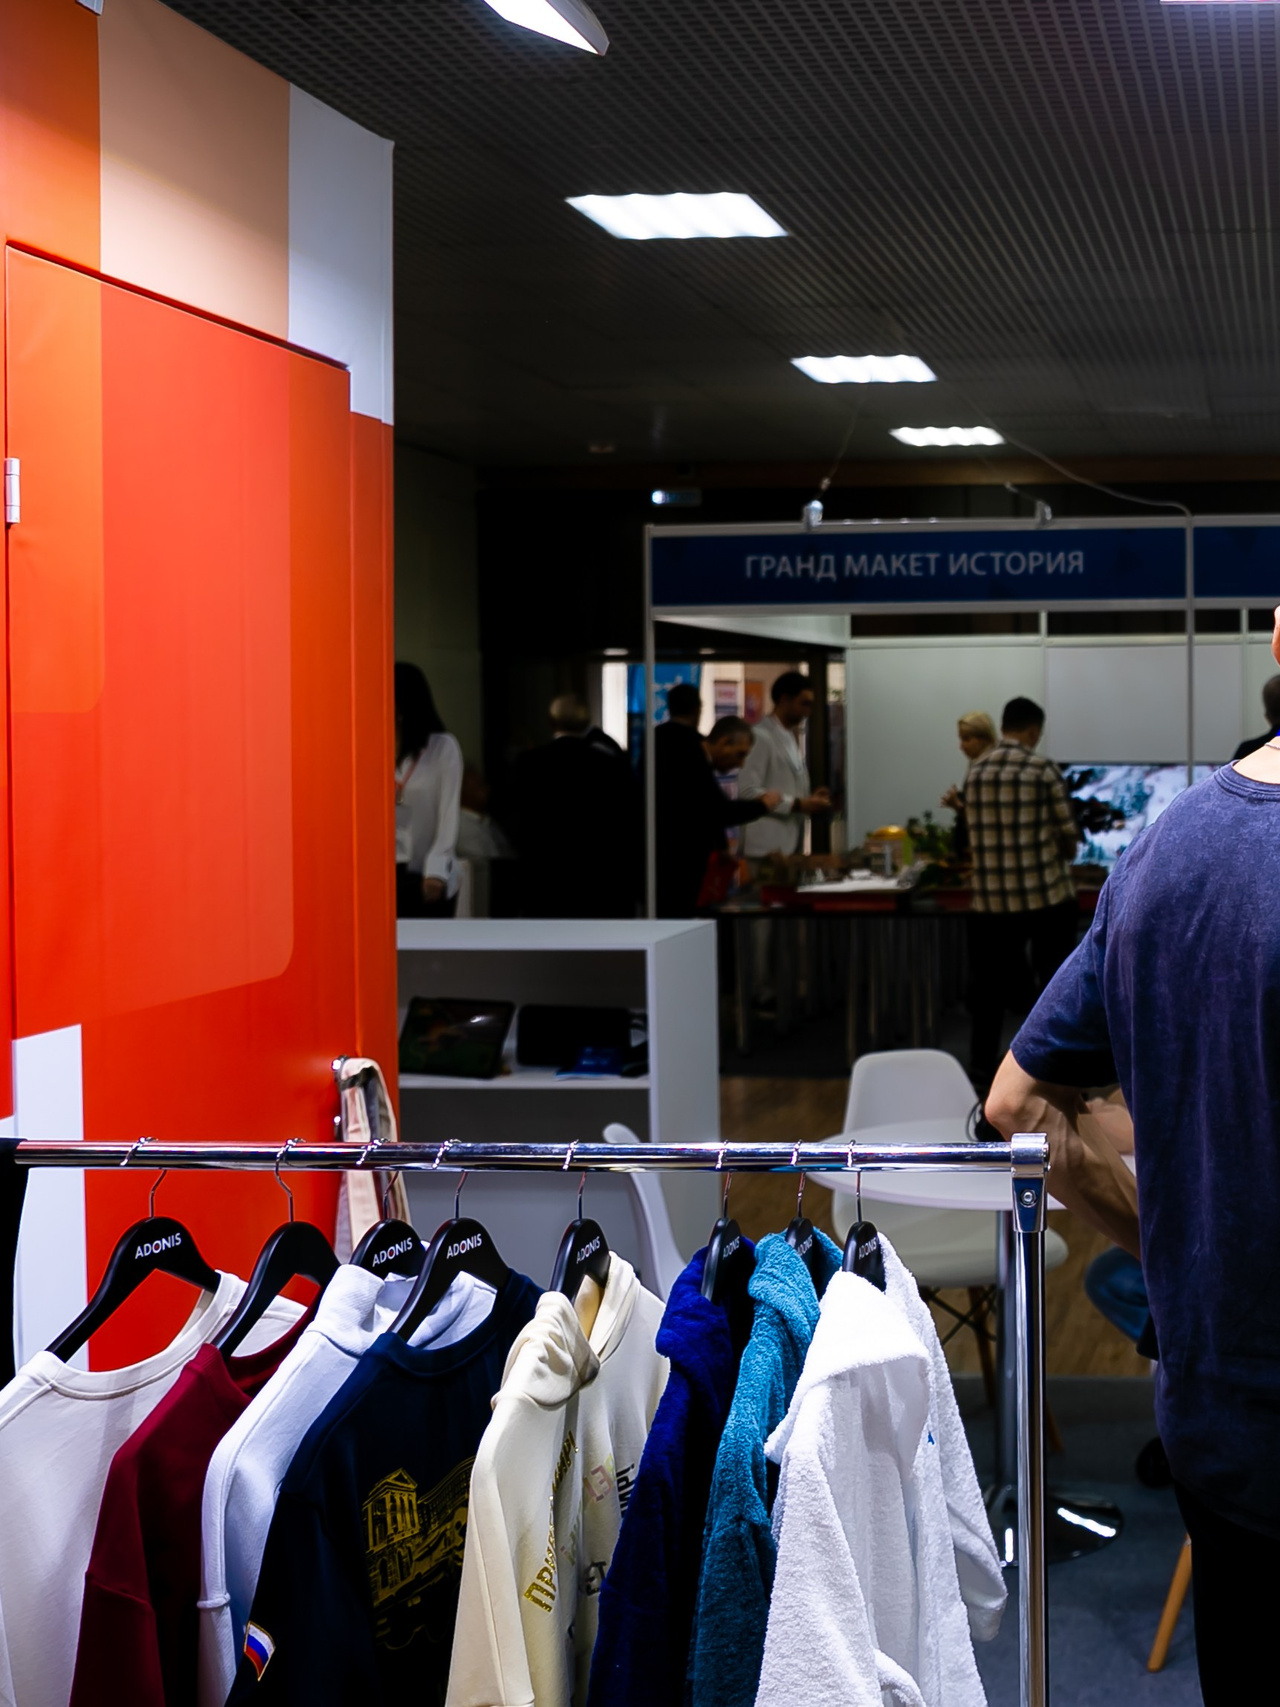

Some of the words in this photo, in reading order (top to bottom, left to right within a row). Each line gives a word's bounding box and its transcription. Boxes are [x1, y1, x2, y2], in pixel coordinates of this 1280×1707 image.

[744, 553, 838, 583] ГРАНД
[843, 551, 941, 578] МАКЕТ
[947, 550, 1085, 577] ИСТОРИЯ
[134, 1232, 182, 1260] ADONIS
[371, 1236, 413, 1268] ADONIS
[446, 1233, 482, 1259] ADONIS
[576, 1235, 600, 1264] ADONIS
